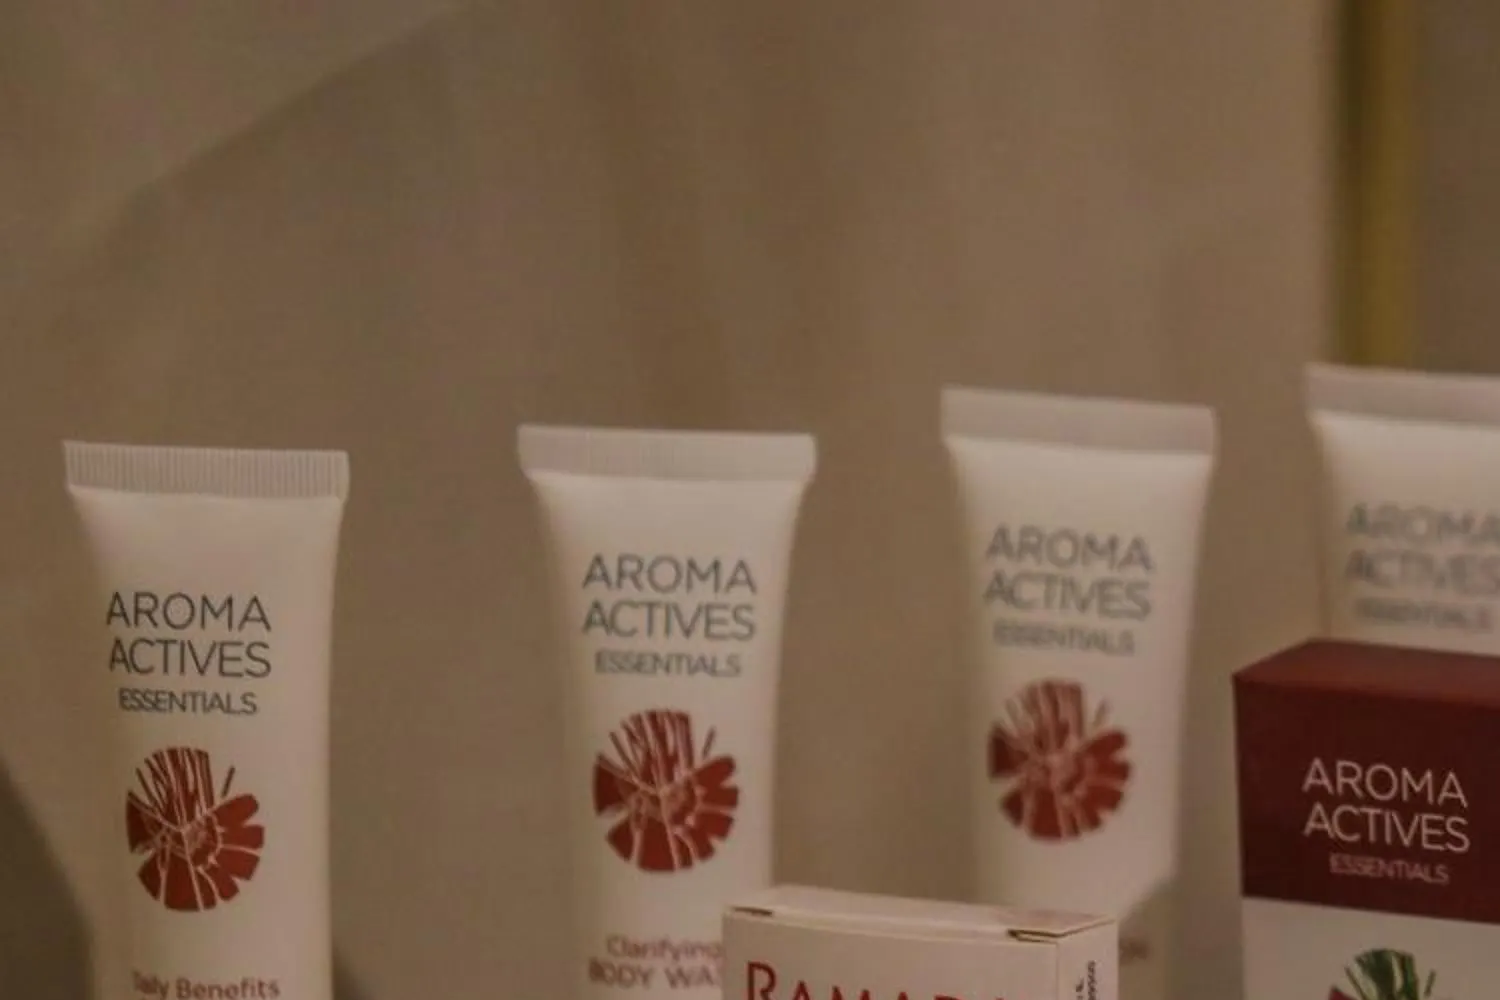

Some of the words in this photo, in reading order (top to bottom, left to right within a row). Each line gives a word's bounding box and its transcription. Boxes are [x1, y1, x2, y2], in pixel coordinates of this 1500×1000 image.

[986, 522, 1156, 574] AROMA
[582, 552, 757, 595] AROMA
[982, 568, 1152, 622] ACTIVES
[105, 591, 272, 632] AROMA
[582, 598, 756, 642] ACTIVES
[108, 636, 272, 678] ACTIVES
[594, 648, 742, 678] ESSENTIALS
[117, 686, 260, 716] ESSENTIALS
[1301, 756, 1469, 809] AROMA
[1302, 801, 1471, 854] ACTIVES
[1329, 851, 1450, 886] ESSENTIALS
